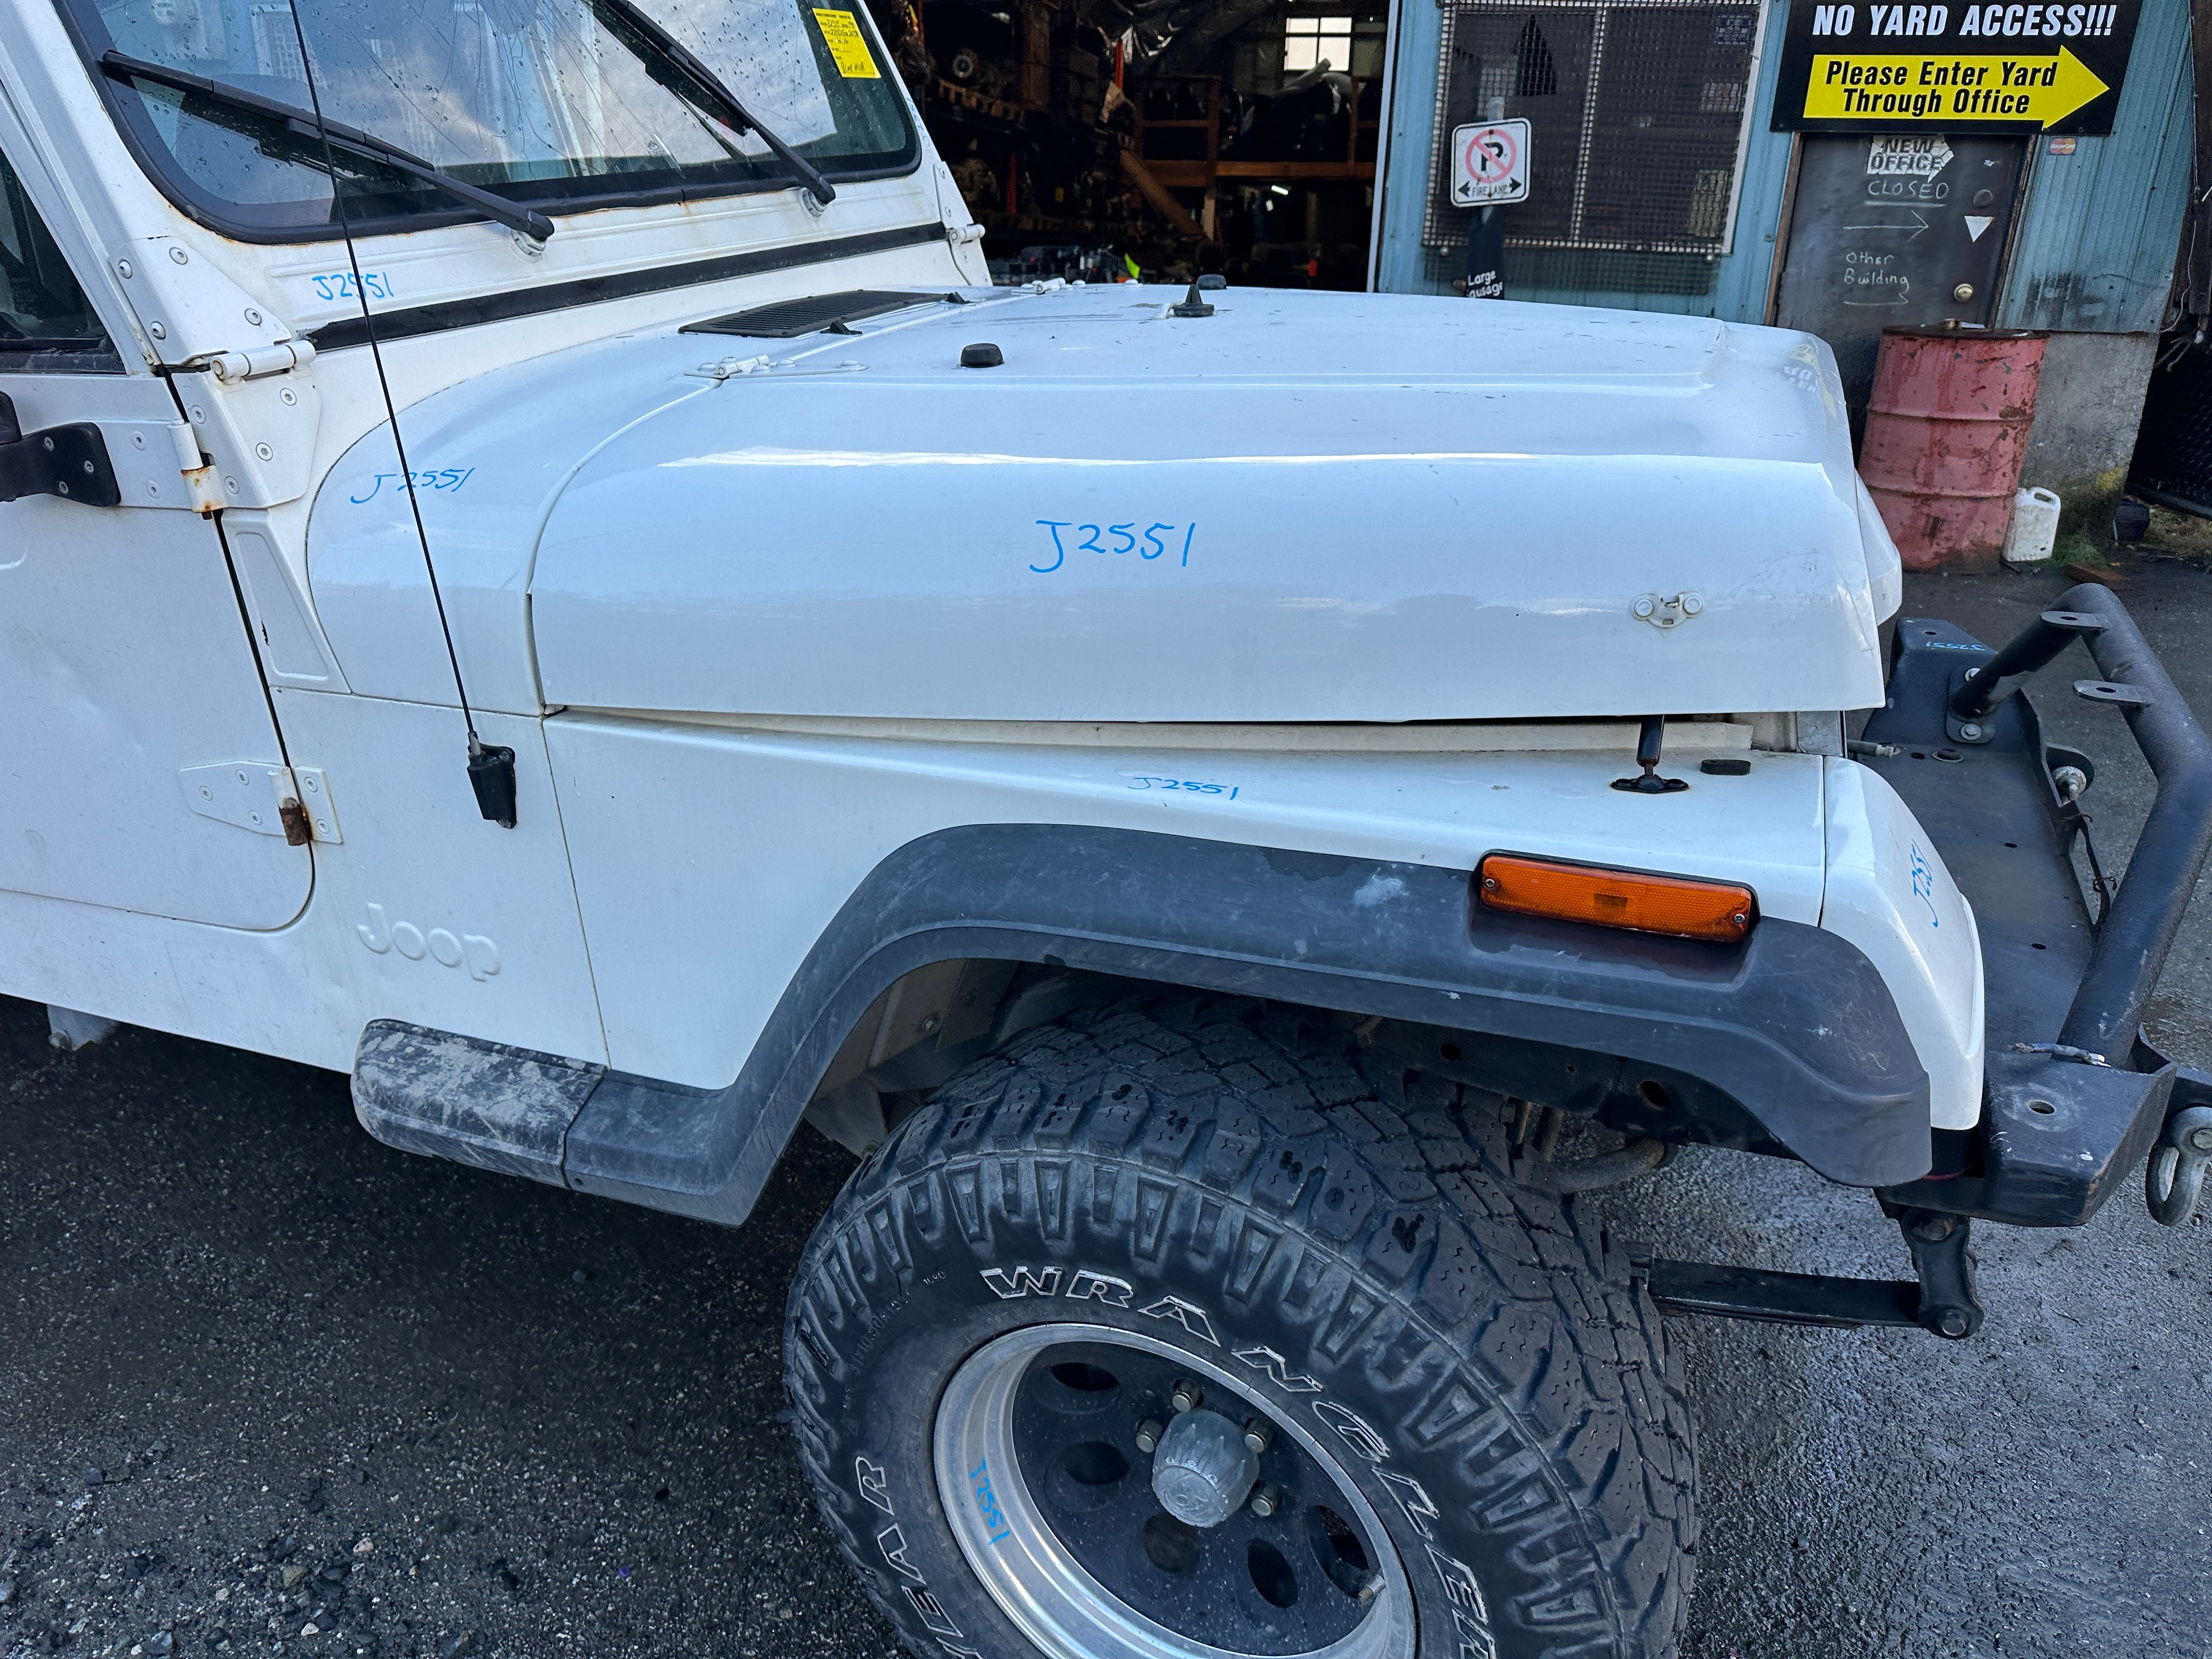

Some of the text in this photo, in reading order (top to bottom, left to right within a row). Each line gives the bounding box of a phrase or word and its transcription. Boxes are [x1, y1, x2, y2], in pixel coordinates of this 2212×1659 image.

[1812, 3, 2115, 36] NO YARD ACCESS!!!
[1825, 60, 2058, 87] Please Enter Yard
[1843, 88, 2031, 116] Through Office
[1882, 138, 1932, 154] NEW
[1871, 152, 1943, 171] OFFICE
[1472, 185, 1487, 197] FIRE
[1868, 180, 1949, 199] CLOSED
[311, 271, 394, 301] J2551
[1466, 281, 1503, 298] ausage
[1467, 270, 1497, 286] Large
[1844, 267, 1910, 294] Building
[350, 467, 475, 505] J2551
[1029, 520, 1196, 573] J2551
[1127, 777, 1239, 801] J2551
[1911, 840, 1939, 928] J2551
[970, 1457, 1010, 1546] J2551
